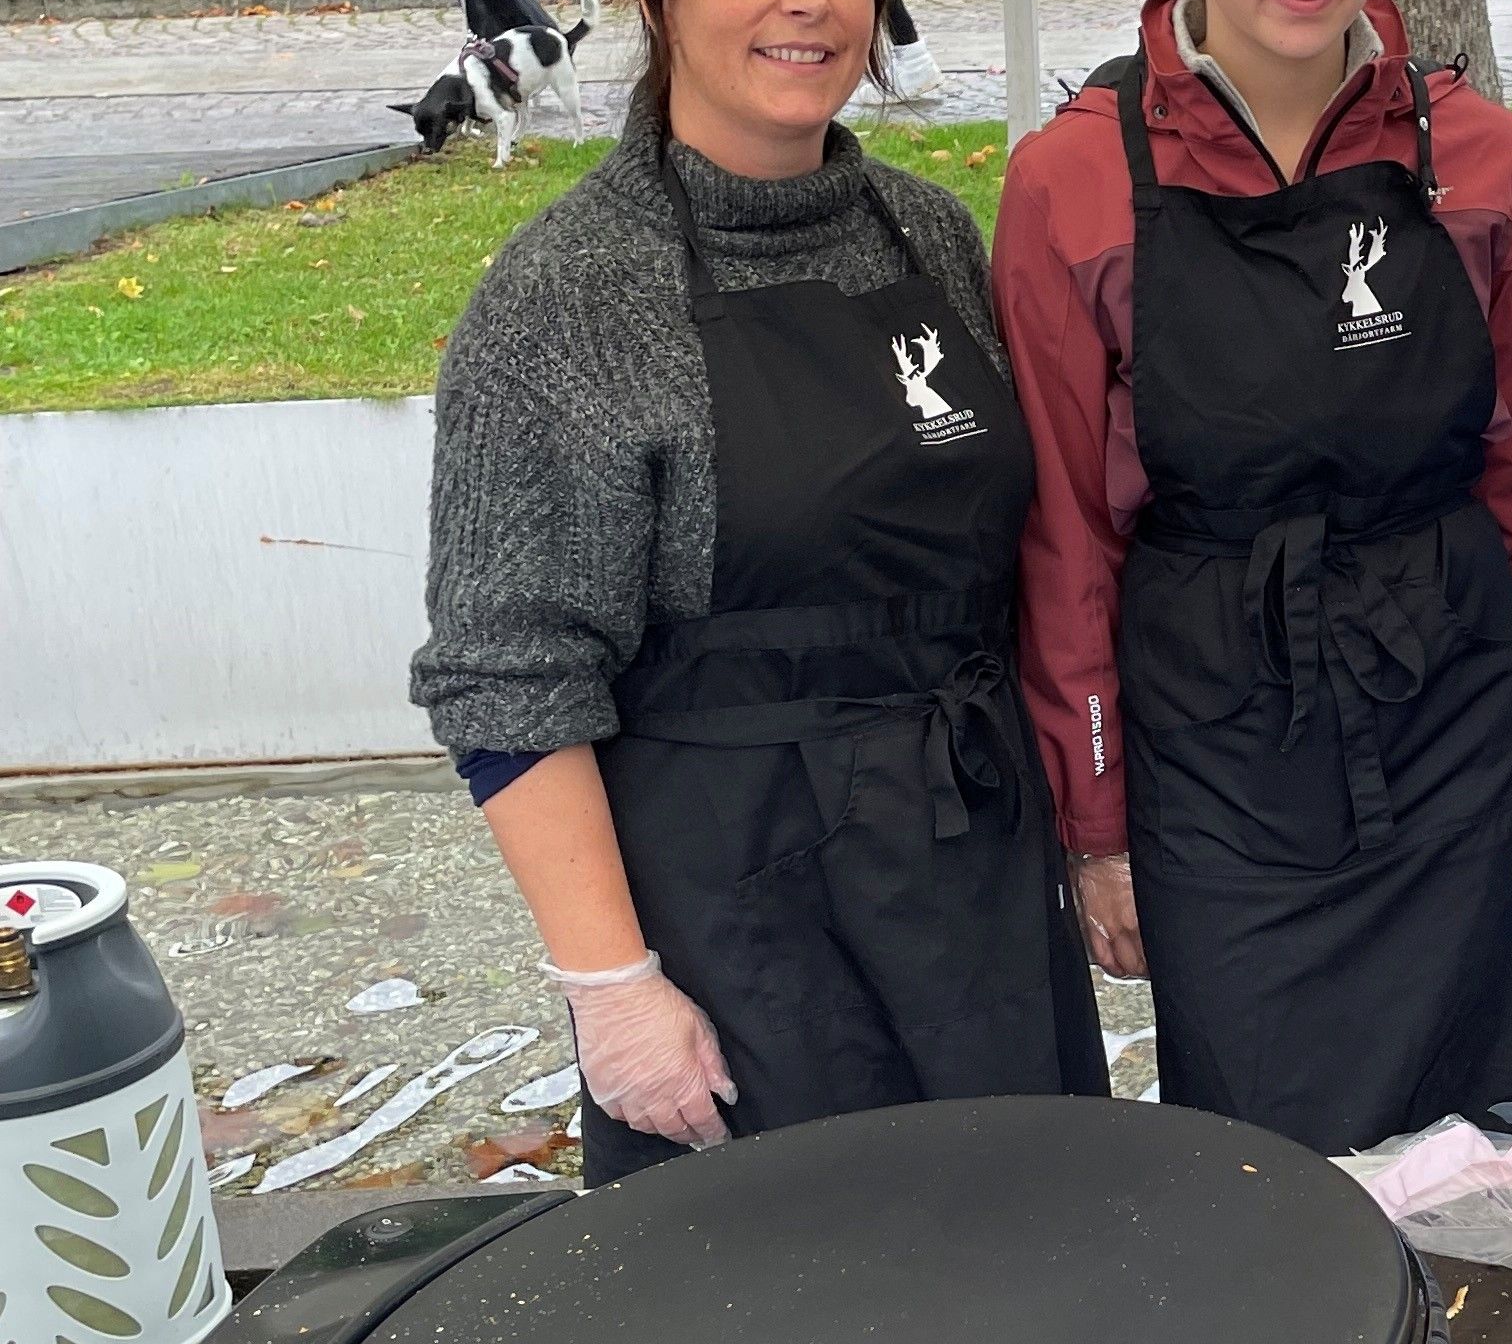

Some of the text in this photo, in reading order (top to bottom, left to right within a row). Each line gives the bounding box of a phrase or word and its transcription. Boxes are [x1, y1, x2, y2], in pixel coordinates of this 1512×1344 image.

[1337, 311, 1403, 333] KYKKELSRUD
[912, 409, 974, 432] KYKKELSRUD
[1088, 694, 1102, 735] 15000
